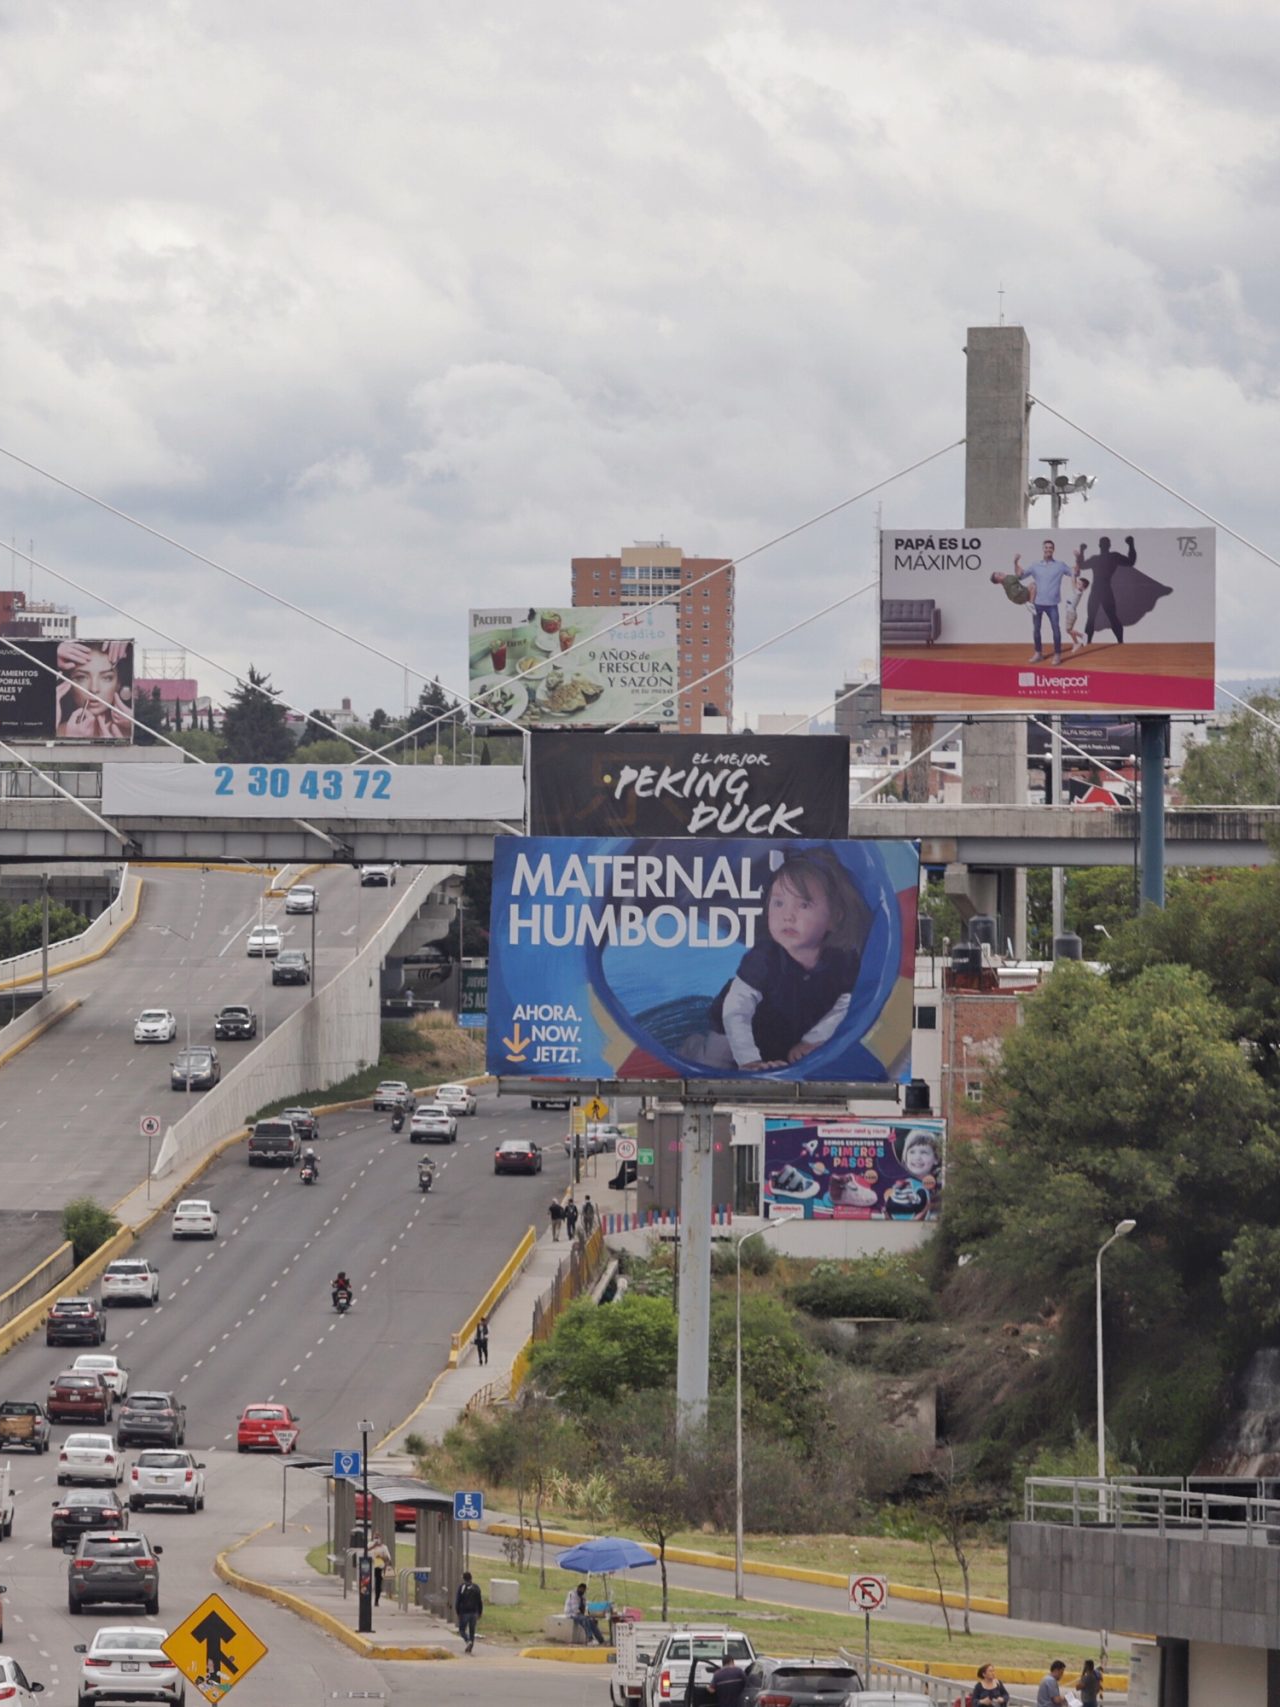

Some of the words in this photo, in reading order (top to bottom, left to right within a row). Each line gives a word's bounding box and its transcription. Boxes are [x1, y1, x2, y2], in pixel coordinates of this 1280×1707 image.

[894, 536, 935, 550] PAPÁ
[938, 538, 958, 550] ES
[961, 538, 982, 550] LO
[894, 551, 982, 571] MÁXIMO
[588, 651, 596, 660] 9
[600, 648, 637, 661] AÑOS
[599, 661, 673, 673] FRESCURA
[607, 676, 616, 687] Y
[620, 673, 673, 688] SAZÓN
[1036, 674, 1088, 689] Liverpool
[17, 686, 23, 694] Y
[692, 753, 712, 765] EL
[714, 753, 771, 768] MEJOR
[214, 768, 235, 796] 2
[247, 766, 290, 798] 30
[299, 770, 343, 800] 43
[353, 770, 393, 800] 72
[614, 766, 749, 803] PEKING
[687, 799, 805, 836] DUCK
[510, 853, 764, 900] MATERNAL
[508, 903, 765, 949] HUMBOLDT
[513, 1005, 583, 1022] AHORA.
[531, 1025, 582, 1042] NOW.
[532, 1045, 582, 1063] JETZT.
[822, 1146, 885, 1158] PRIMEROS
[833, 1157, 874, 1168] PASOS
[464, 1494, 472, 1505] E
